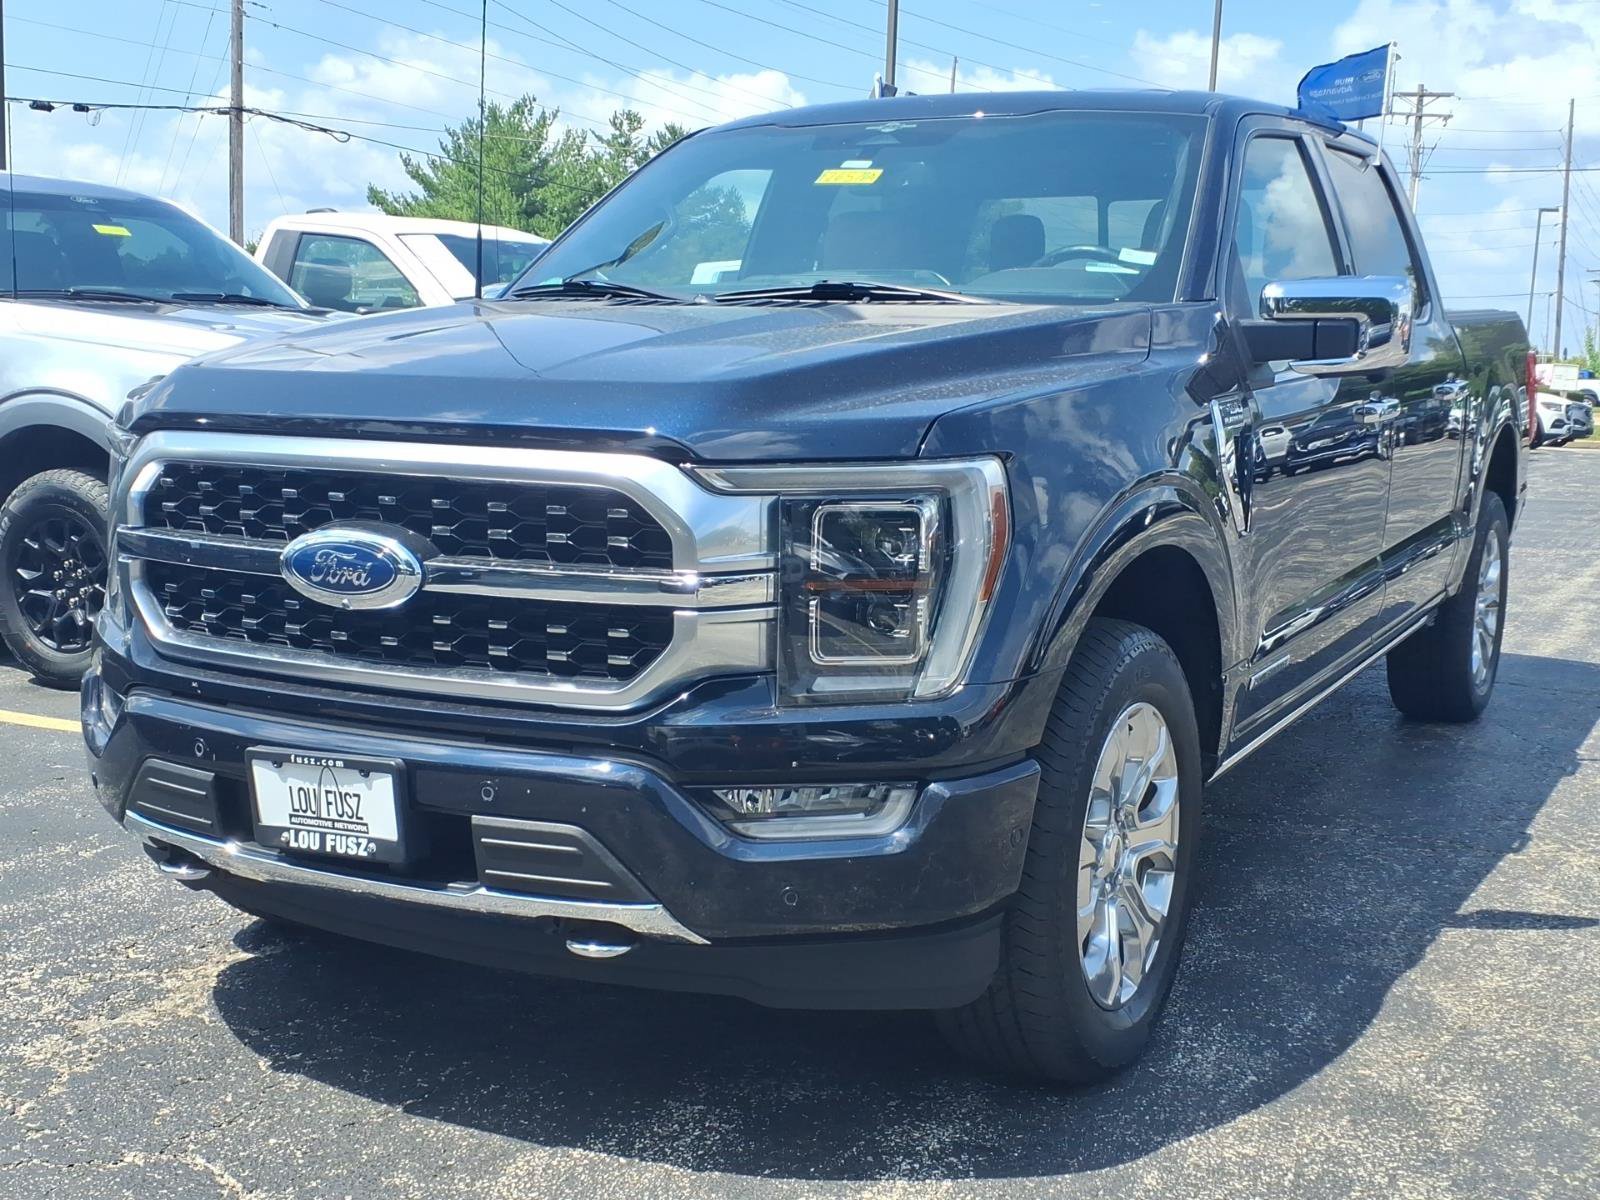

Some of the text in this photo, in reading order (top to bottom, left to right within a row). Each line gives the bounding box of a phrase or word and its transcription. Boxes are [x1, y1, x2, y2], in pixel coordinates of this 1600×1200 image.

[309, 549, 373, 587] Ford
[290, 754, 345, 768] fusz.com
[289, 785, 364, 821] LOU FUSZ
[291, 816, 369, 833] AUTOMOTIVE NETWORK
[289, 829, 370, 857] LOU FUSZ
